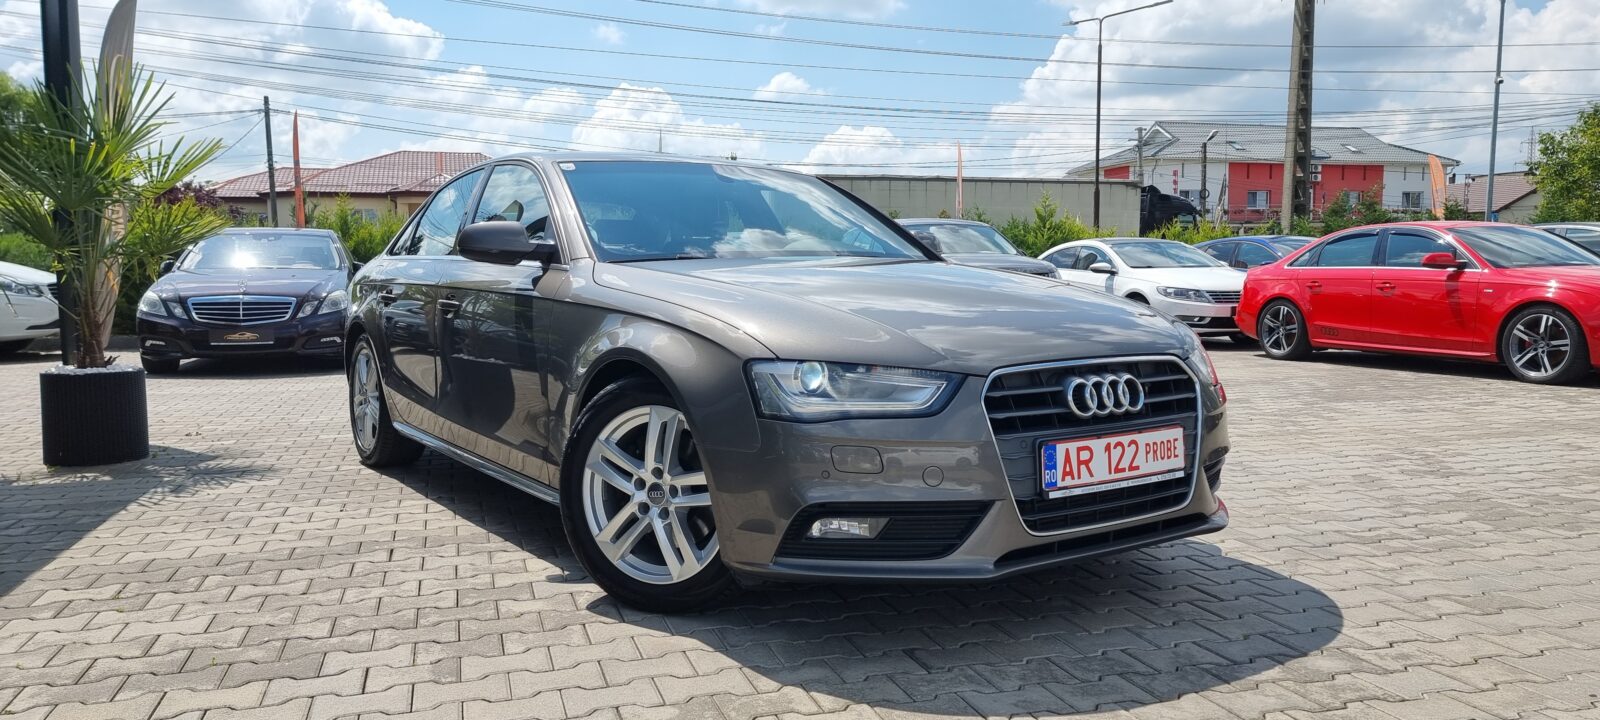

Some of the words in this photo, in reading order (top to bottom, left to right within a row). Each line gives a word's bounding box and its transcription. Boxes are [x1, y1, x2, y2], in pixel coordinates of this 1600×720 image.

[1061, 445, 1094, 482] AR
[1104, 439, 1140, 475] 122
[1145, 438, 1179, 463] PROBE
[1045, 469, 1057, 483] RO
